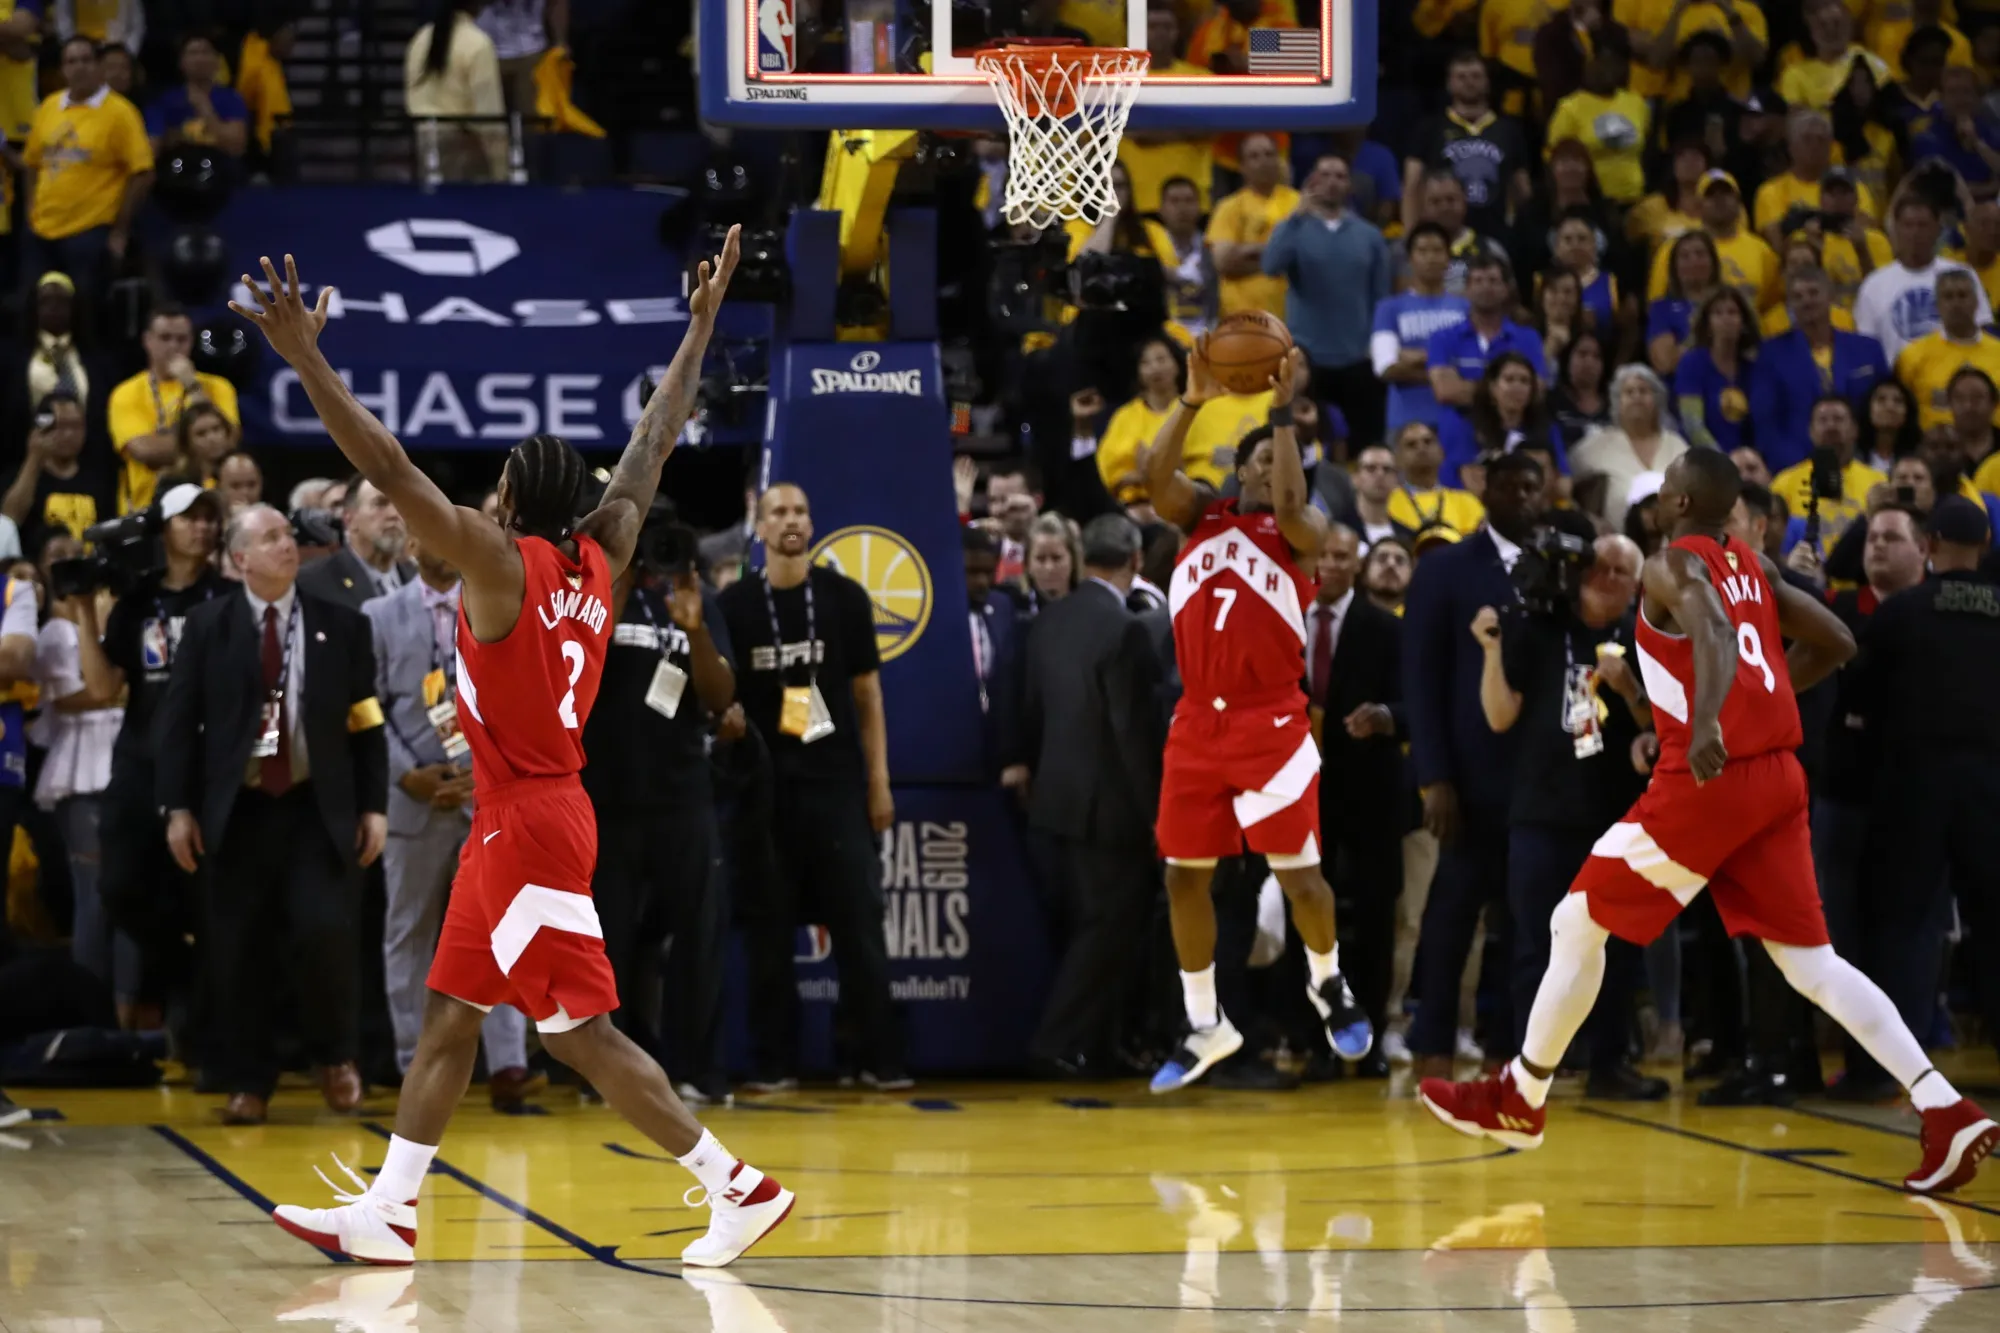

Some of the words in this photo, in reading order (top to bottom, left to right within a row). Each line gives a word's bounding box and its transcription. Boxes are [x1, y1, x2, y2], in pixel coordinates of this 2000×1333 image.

[746, 87, 808, 101] SPALDING
[231, 281, 687, 327] CHASE
[270, 367, 603, 438] CHASE
[811, 367, 922, 396] SPALDING
[1188, 541, 1279, 593] NORTH
[538, 588, 607, 635] LEONARD
[1213, 587, 1237, 631] 7
[1934, 594, 2000, 616] SQUAD
[1737, 621, 1775, 694] 9
[558, 640, 586, 729] 2
[880, 822, 920, 888] BA
[921, 821, 968, 888] 2019
[883, 890, 970, 959] NALS
